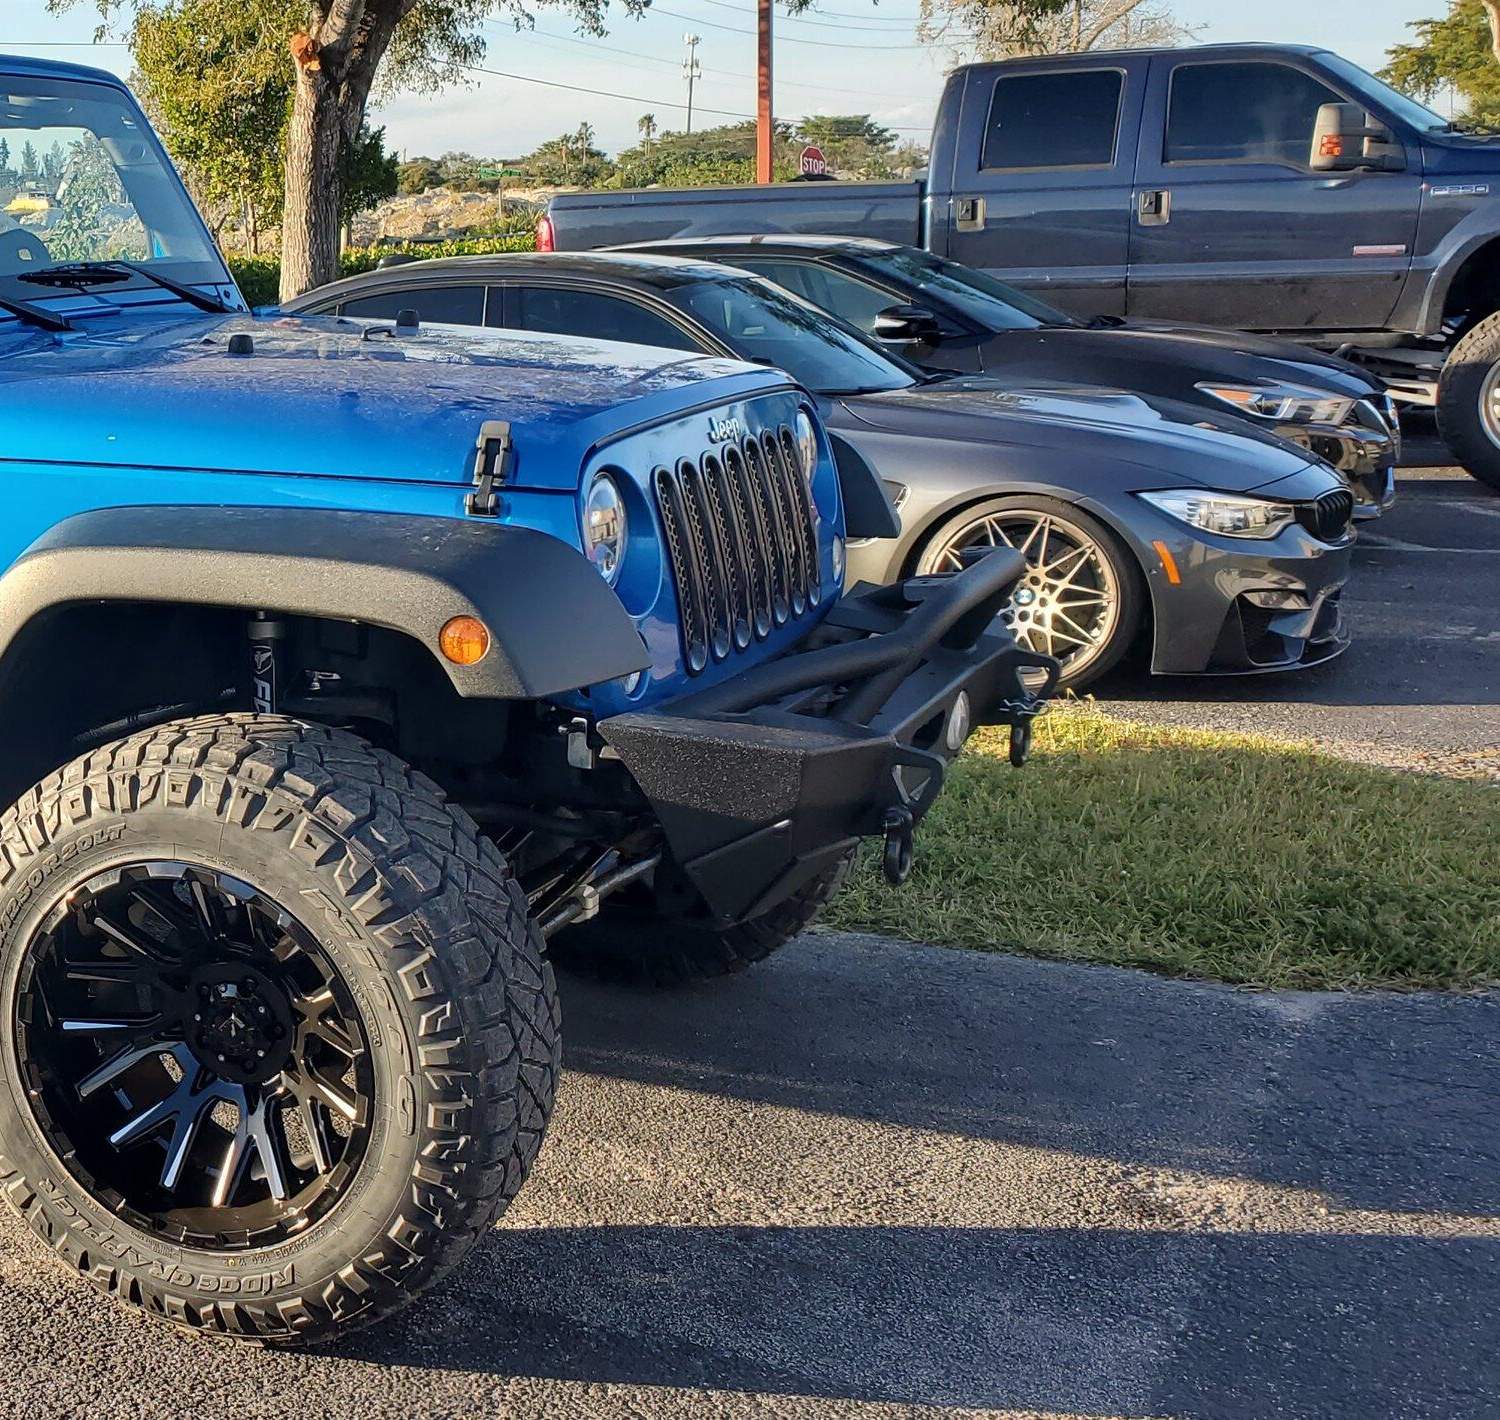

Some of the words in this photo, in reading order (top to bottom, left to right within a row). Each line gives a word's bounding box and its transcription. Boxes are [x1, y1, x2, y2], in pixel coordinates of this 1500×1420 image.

[803, 156, 825, 174] STOP
[708, 416, 740, 443] Jeep
[39, 1177, 195, 1287] GRAPPLER
[197, 1262, 296, 1296] RIDGE
